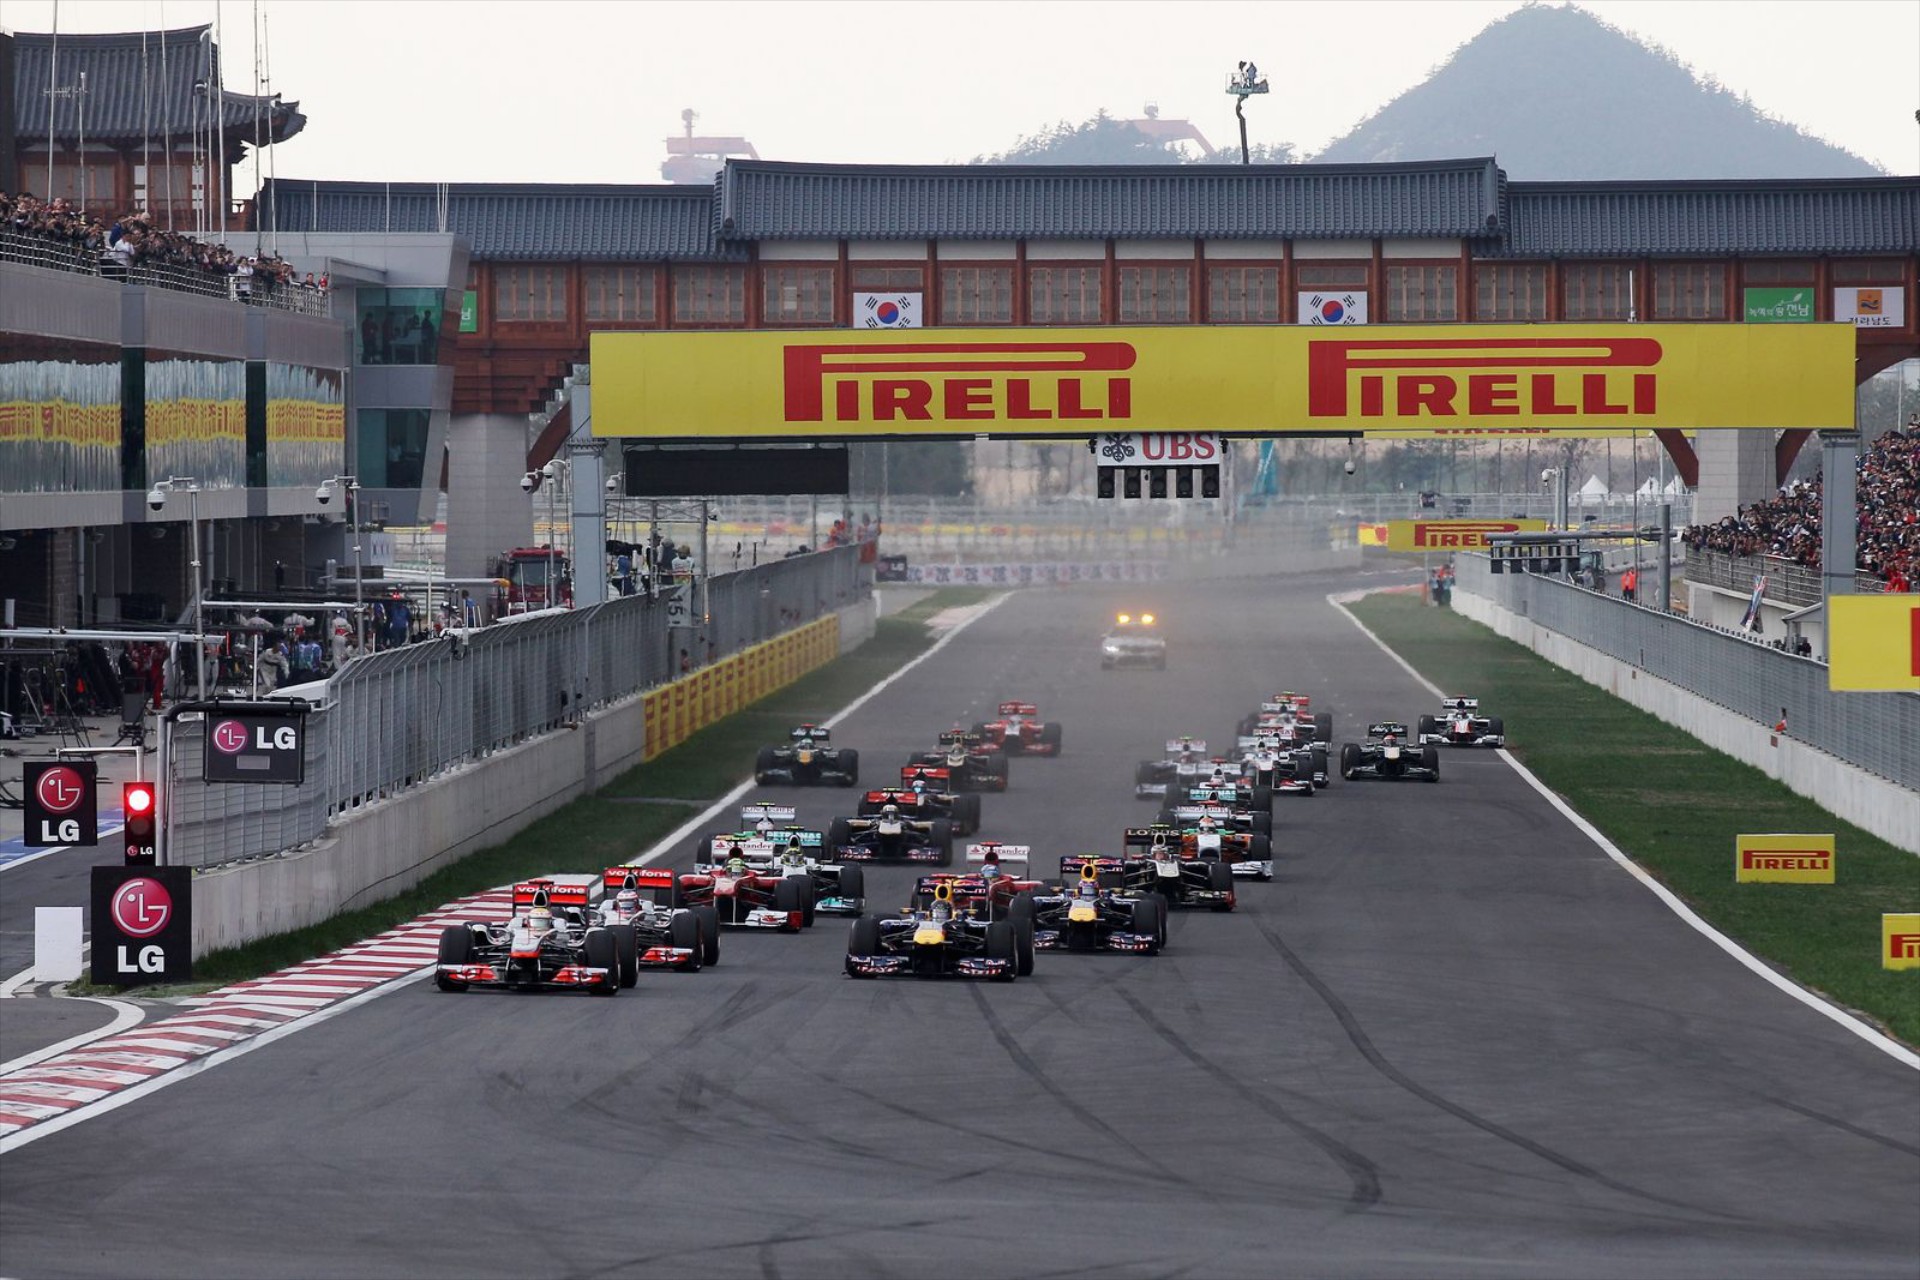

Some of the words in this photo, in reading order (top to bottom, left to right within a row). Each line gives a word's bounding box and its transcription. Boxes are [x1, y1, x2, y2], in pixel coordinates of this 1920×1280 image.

[784, 342, 1137, 422] PIRELLI
[1308, 338, 1664, 417] PIRELLI
[1141, 432, 1215, 460] UBS
[1415, 523, 1519, 546] PIREL
[257, 727, 296, 750] LG
[41, 819, 80, 842] LG
[767, 831, 822, 840] PETRNAS
[140, 846, 153, 855] LG
[1743, 850, 1830, 869] PIRELLI
[608, 869, 671, 878] vofone
[517, 885, 585, 894] vofone
[117, 945, 165, 973] LG
